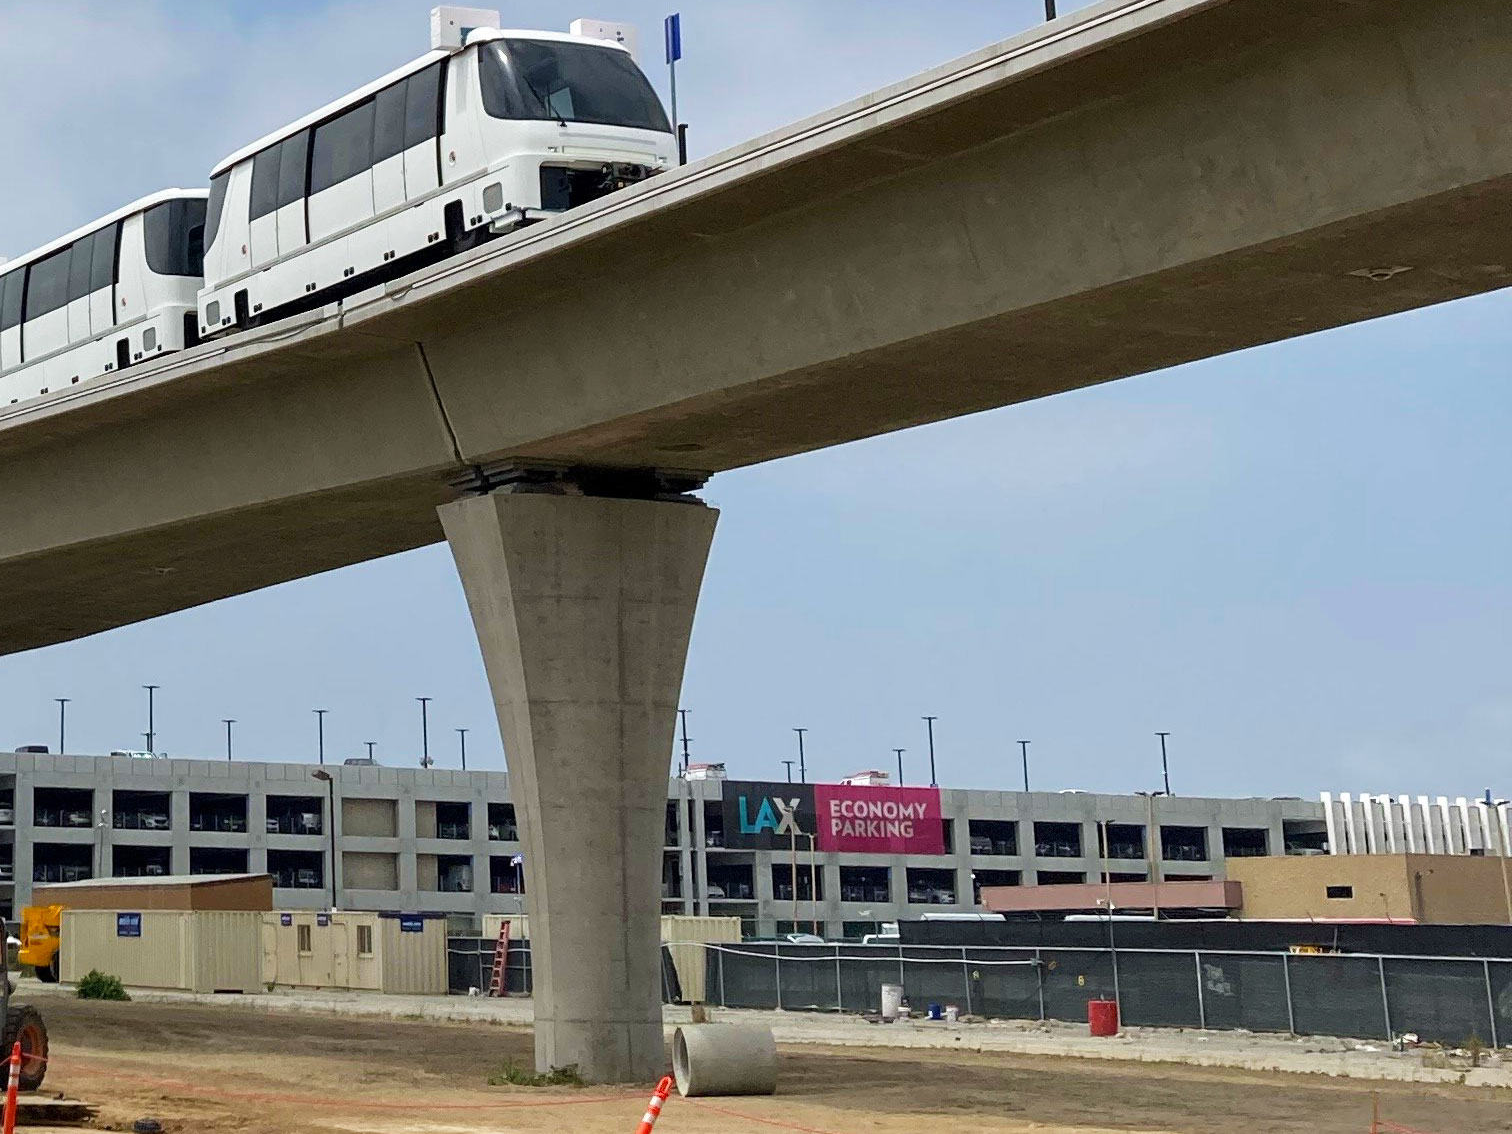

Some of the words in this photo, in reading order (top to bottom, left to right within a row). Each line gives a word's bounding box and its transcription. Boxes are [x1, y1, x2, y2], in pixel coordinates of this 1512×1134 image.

[738, 796, 802, 835] LAX
[829, 799, 928, 820] ECONOMY
[830, 820, 915, 838] PARKING
